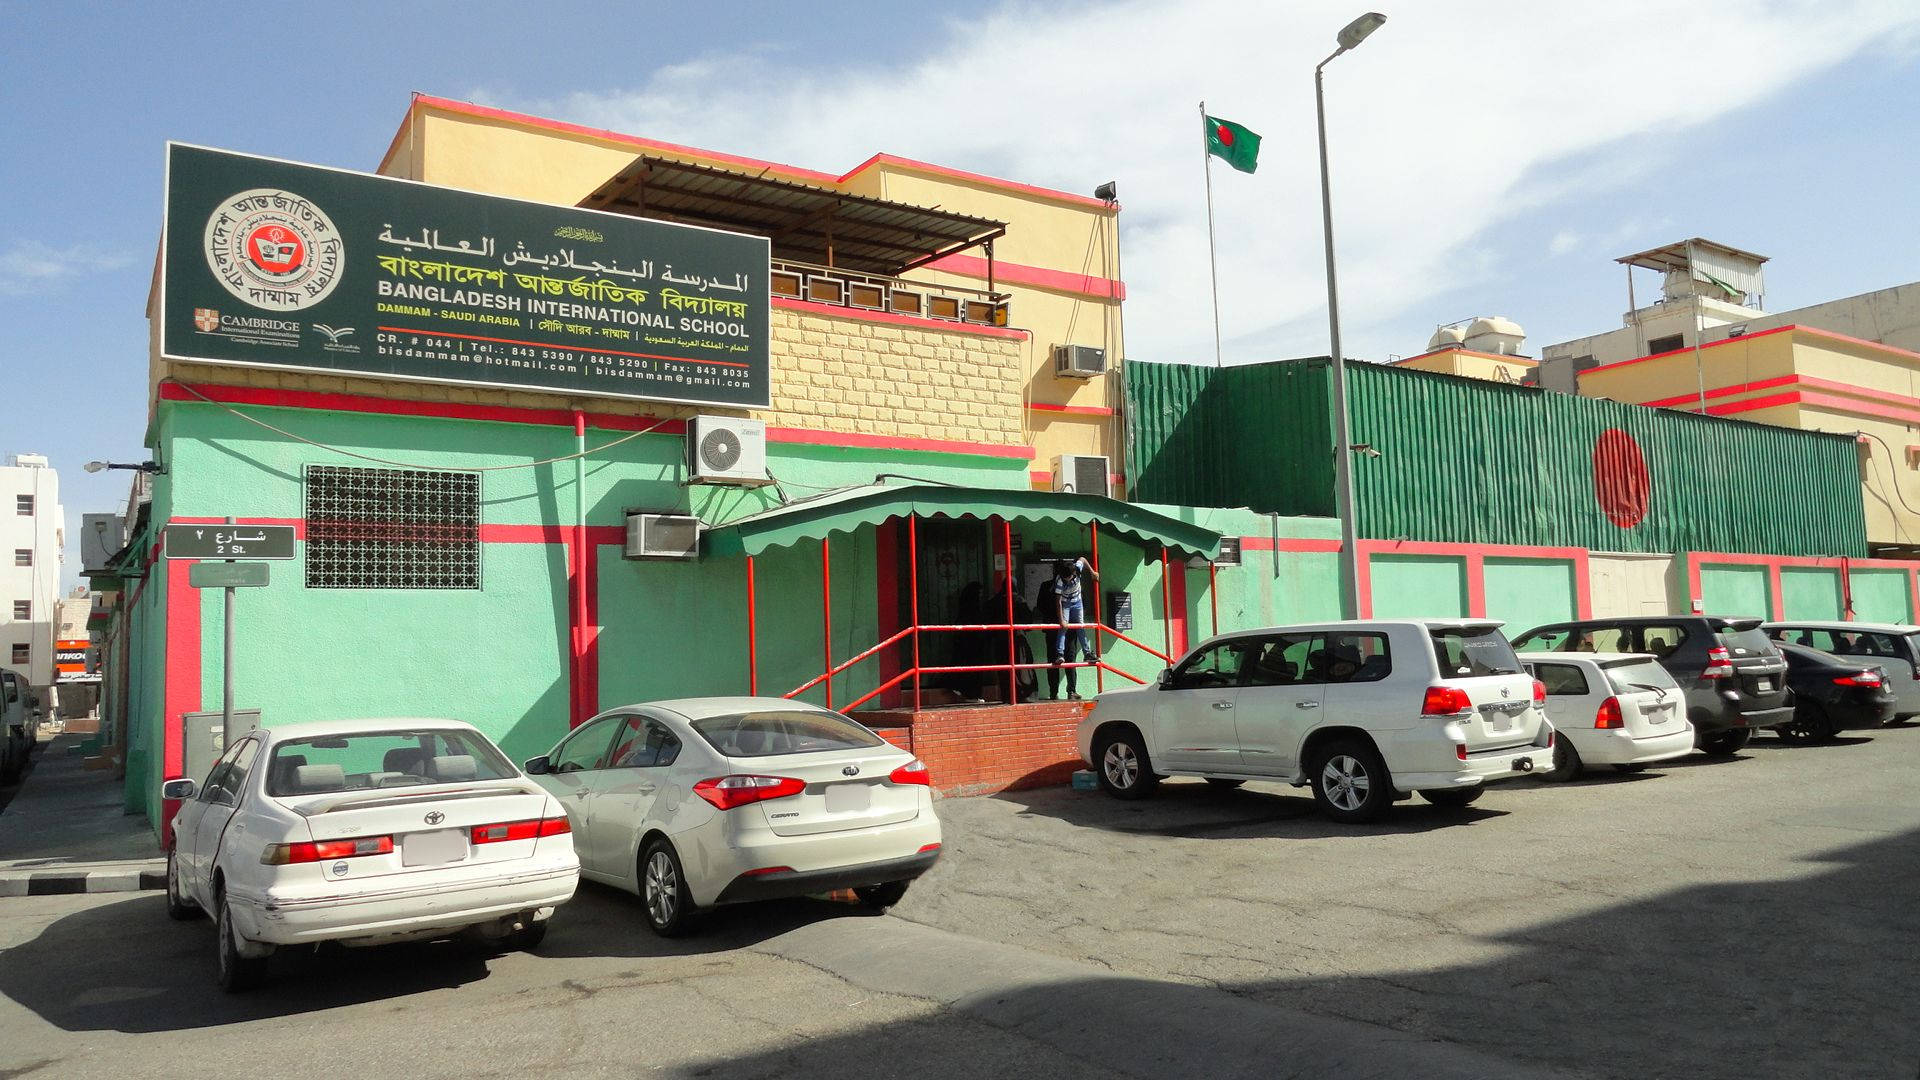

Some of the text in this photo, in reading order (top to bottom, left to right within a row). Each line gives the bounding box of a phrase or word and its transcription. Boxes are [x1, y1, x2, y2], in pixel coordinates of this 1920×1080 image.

[210, 211, 244, 291] বাংলাদেশ
[378, 223, 748, 292] المدرسة البنجلاديش العالمية
[376, 255, 748, 319] বাংলাদেশ আন্তর্জাতিক বিদ্যালয়
[377, 303, 431, 317] DAMMAM
[441, 310, 475, 321] SAUDI
[479, 314, 520, 327] ARABIA
[378, 280, 750, 338] BANGLADESH INTERNATIONAL SCHOOL
[221, 315, 300, 332] CAMBRIDGE
[221, 326, 300, 339] International Examinations
[538, 319, 564, 333] সৌদি
[566, 324, 593, 336] আরব
[377, 333, 403, 344] CR.
[426, 338, 451, 349] 044
[512, 347, 535, 357] 843
[542, 350, 573, 361] 5390
[590, 355, 612, 365] 843
[619, 358, 648, 368] 5290
[664, 363, 691, 373] Fax:
[696, 365, 717, 375] 843
[722, 368, 749, 378] 8035
[378, 346, 577, 373] bisdammam@hotmail.com
[596, 367, 750, 389] bisdammam@gmail.com
[196, 529, 266, 544] شارع ٢
[216, 545, 246, 554] 2 St.
[770, 811, 800, 819] CERATO
